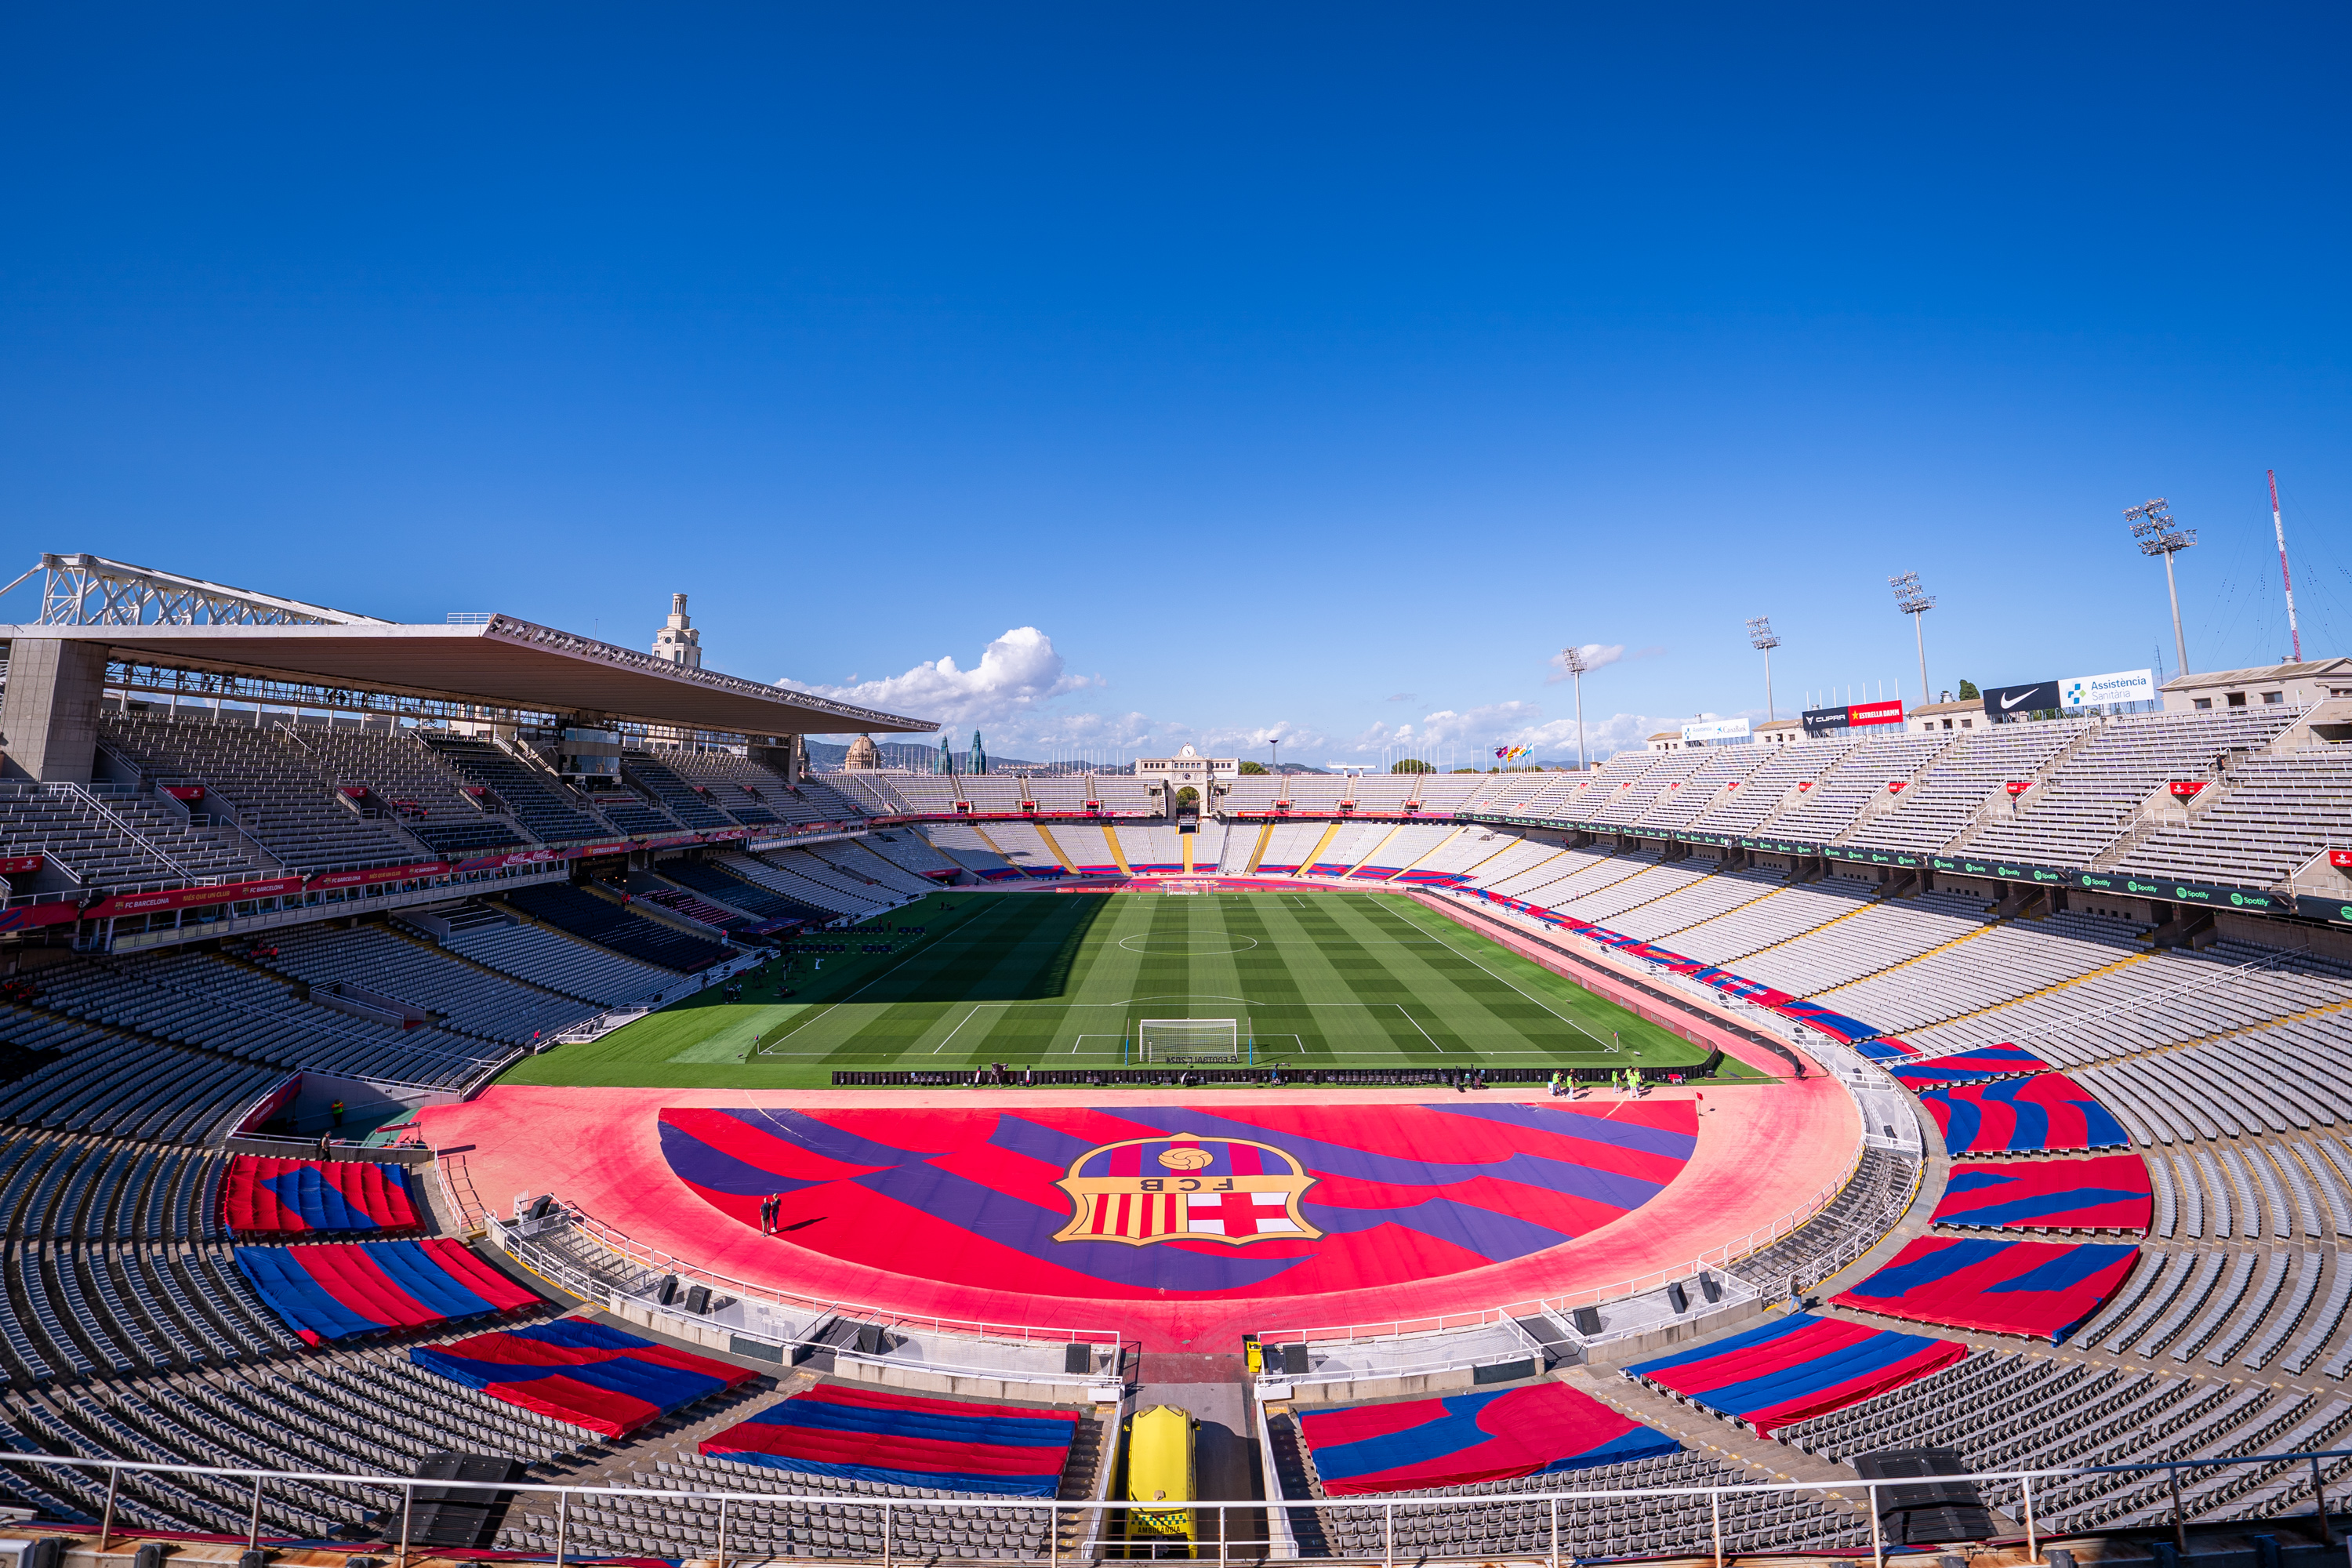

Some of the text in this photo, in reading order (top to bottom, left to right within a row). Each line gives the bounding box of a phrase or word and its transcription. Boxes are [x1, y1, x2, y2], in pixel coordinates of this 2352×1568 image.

[2091, 676, 2147, 690] Assistència
[2092, 689, 2131, 701] Sanitària
[1816, 713, 1846, 723] CUPRA
[1859, 709, 1900, 719] ESTRELLA DAMM
[1722, 724, 1747, 734] CaixaBank
[507, 850, 550, 863] Coca-Cola Coca-Cola
[256, 884, 284, 892] BARCELONA
[2092, 879, 2111, 887] Spotify
[2137, 884, 2158, 893] Spotify
[2187, 891, 2210, 899] Spotify
[133, 898, 169, 908] BARCELONA
[2244, 897, 2270, 907] Spotify
[1591, 984, 1610, 998] NEW ALBUM
[1725, 977, 1767, 996] FC BARCELONA
[1650, 1012, 1675, 1029] NEW ALBUM
[1691, 1033, 1703, 1046] Spotify
[1140, 1178, 1234, 1191] FCB
